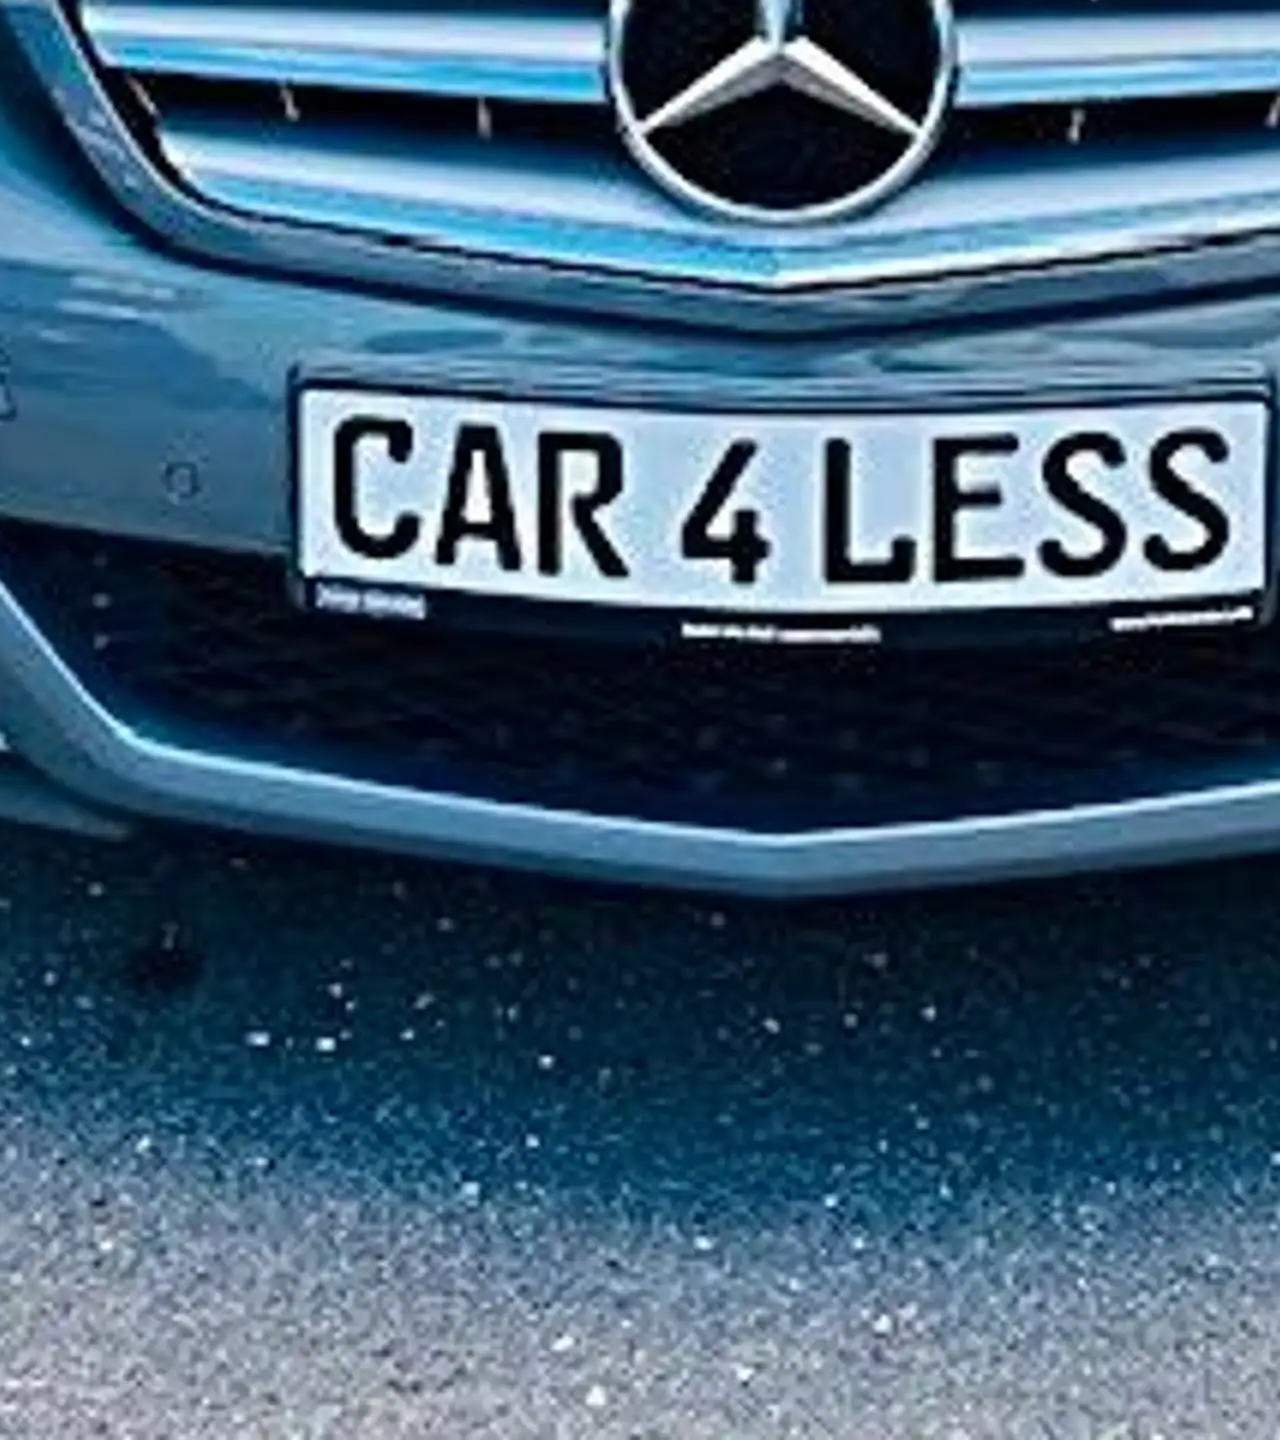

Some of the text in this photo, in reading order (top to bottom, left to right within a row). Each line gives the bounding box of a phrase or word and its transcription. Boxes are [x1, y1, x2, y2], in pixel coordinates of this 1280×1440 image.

[332, 416, 1231, 584] CAR 4 LESS
